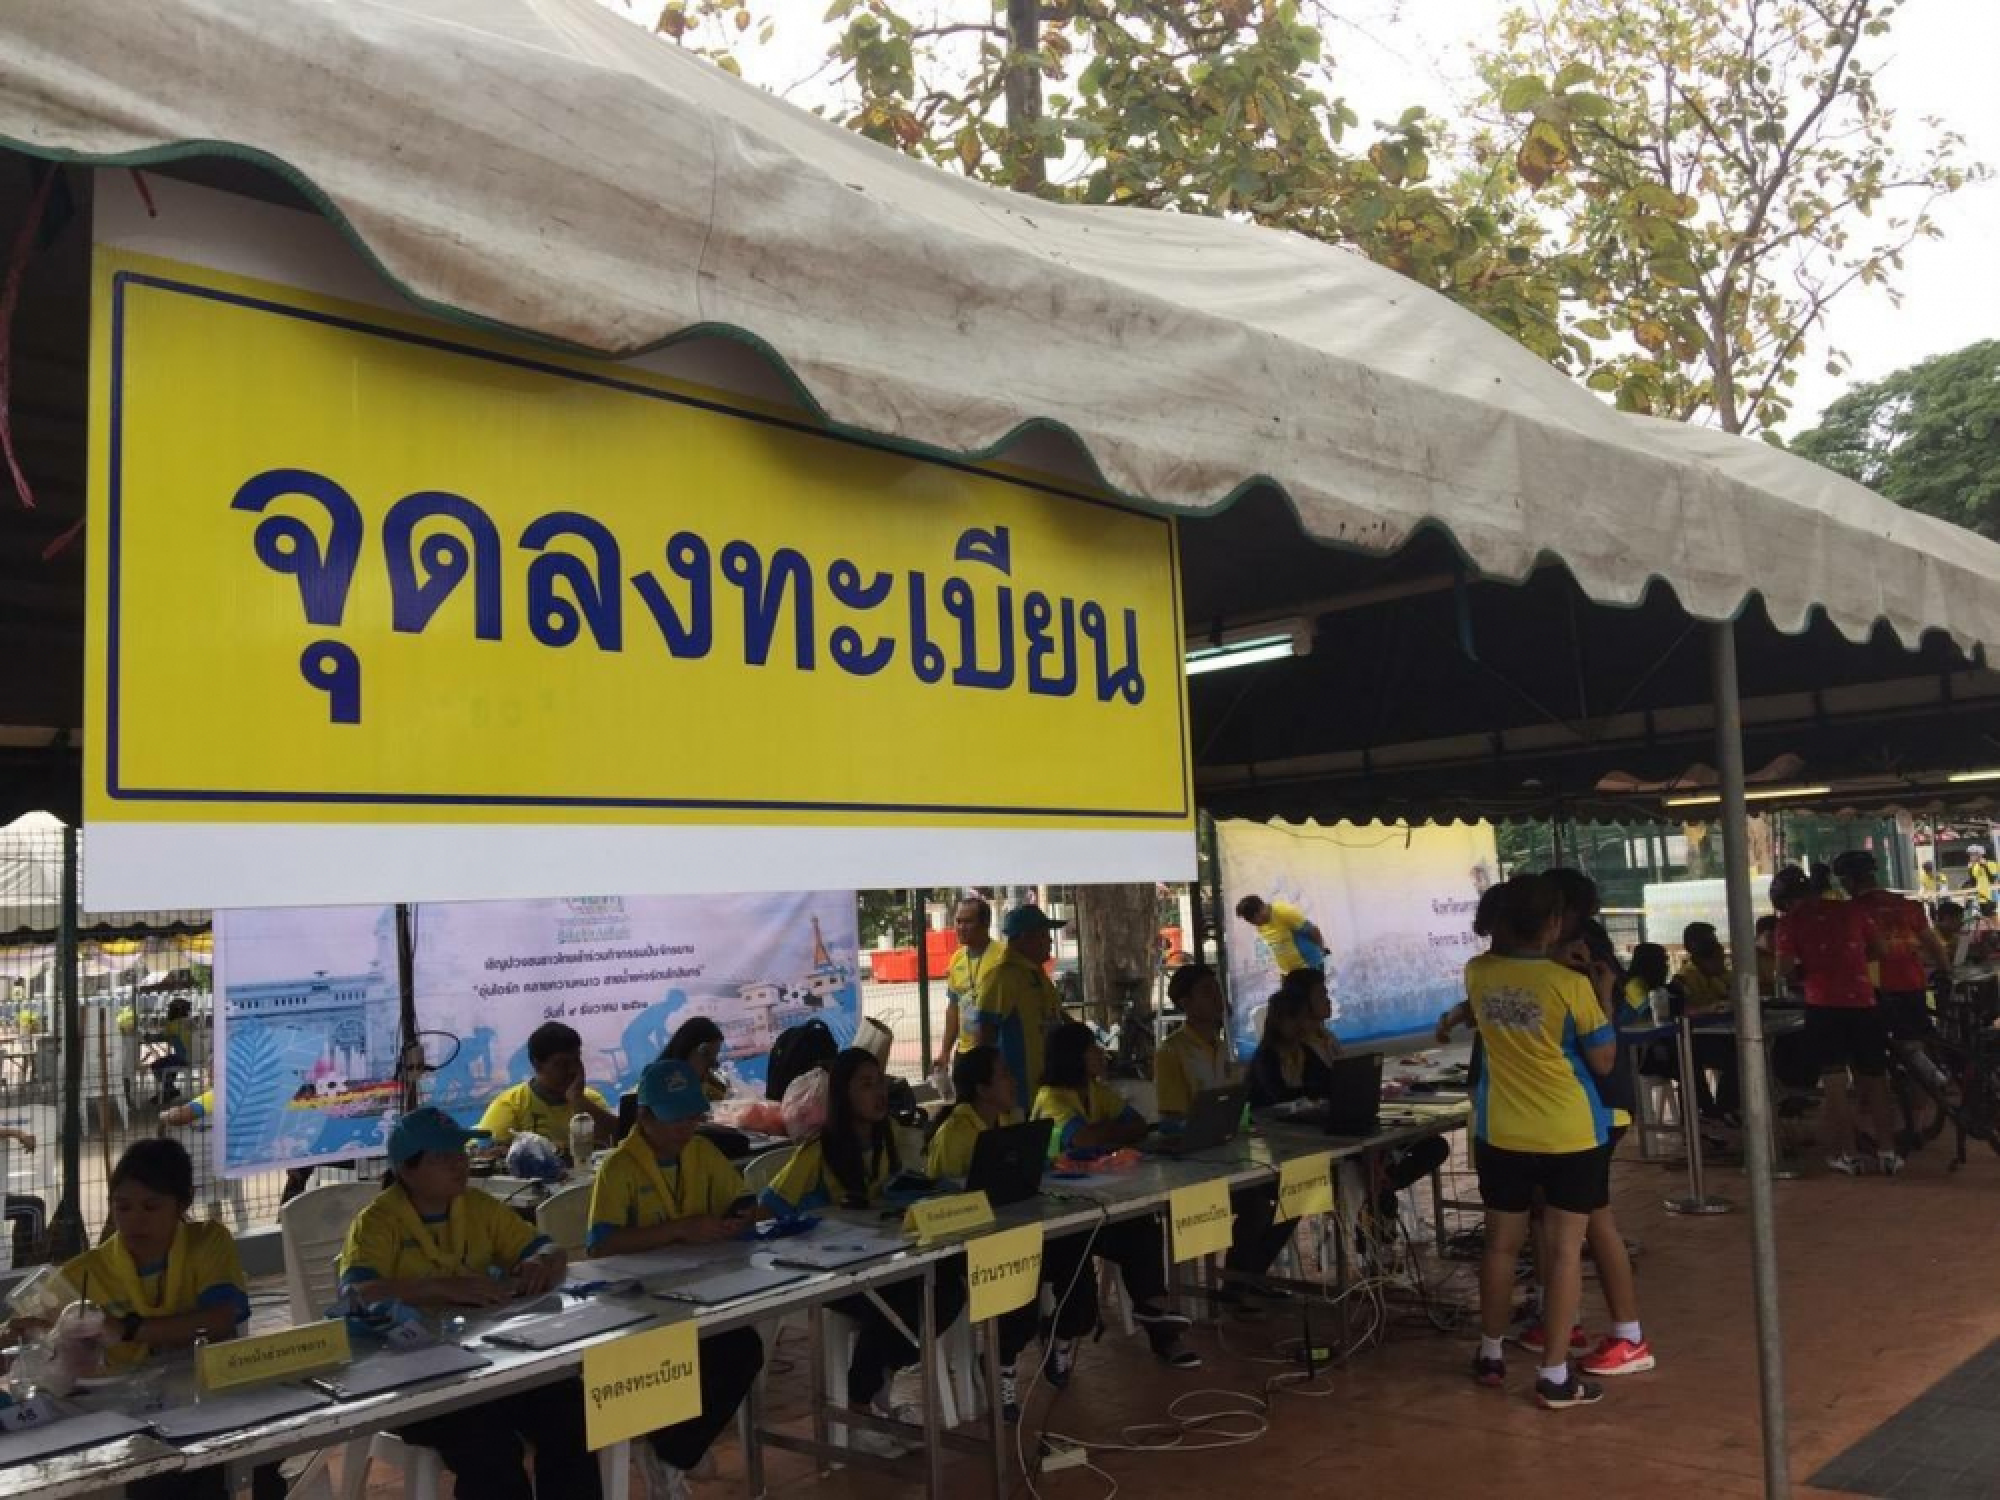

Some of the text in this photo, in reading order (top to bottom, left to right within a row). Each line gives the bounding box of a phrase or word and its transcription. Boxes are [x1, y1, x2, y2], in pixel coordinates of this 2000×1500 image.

[230, 467, 1146, 726] จุดลงทะเบียน
[591, 1359, 693, 1411] จุดลงทะเบียน
